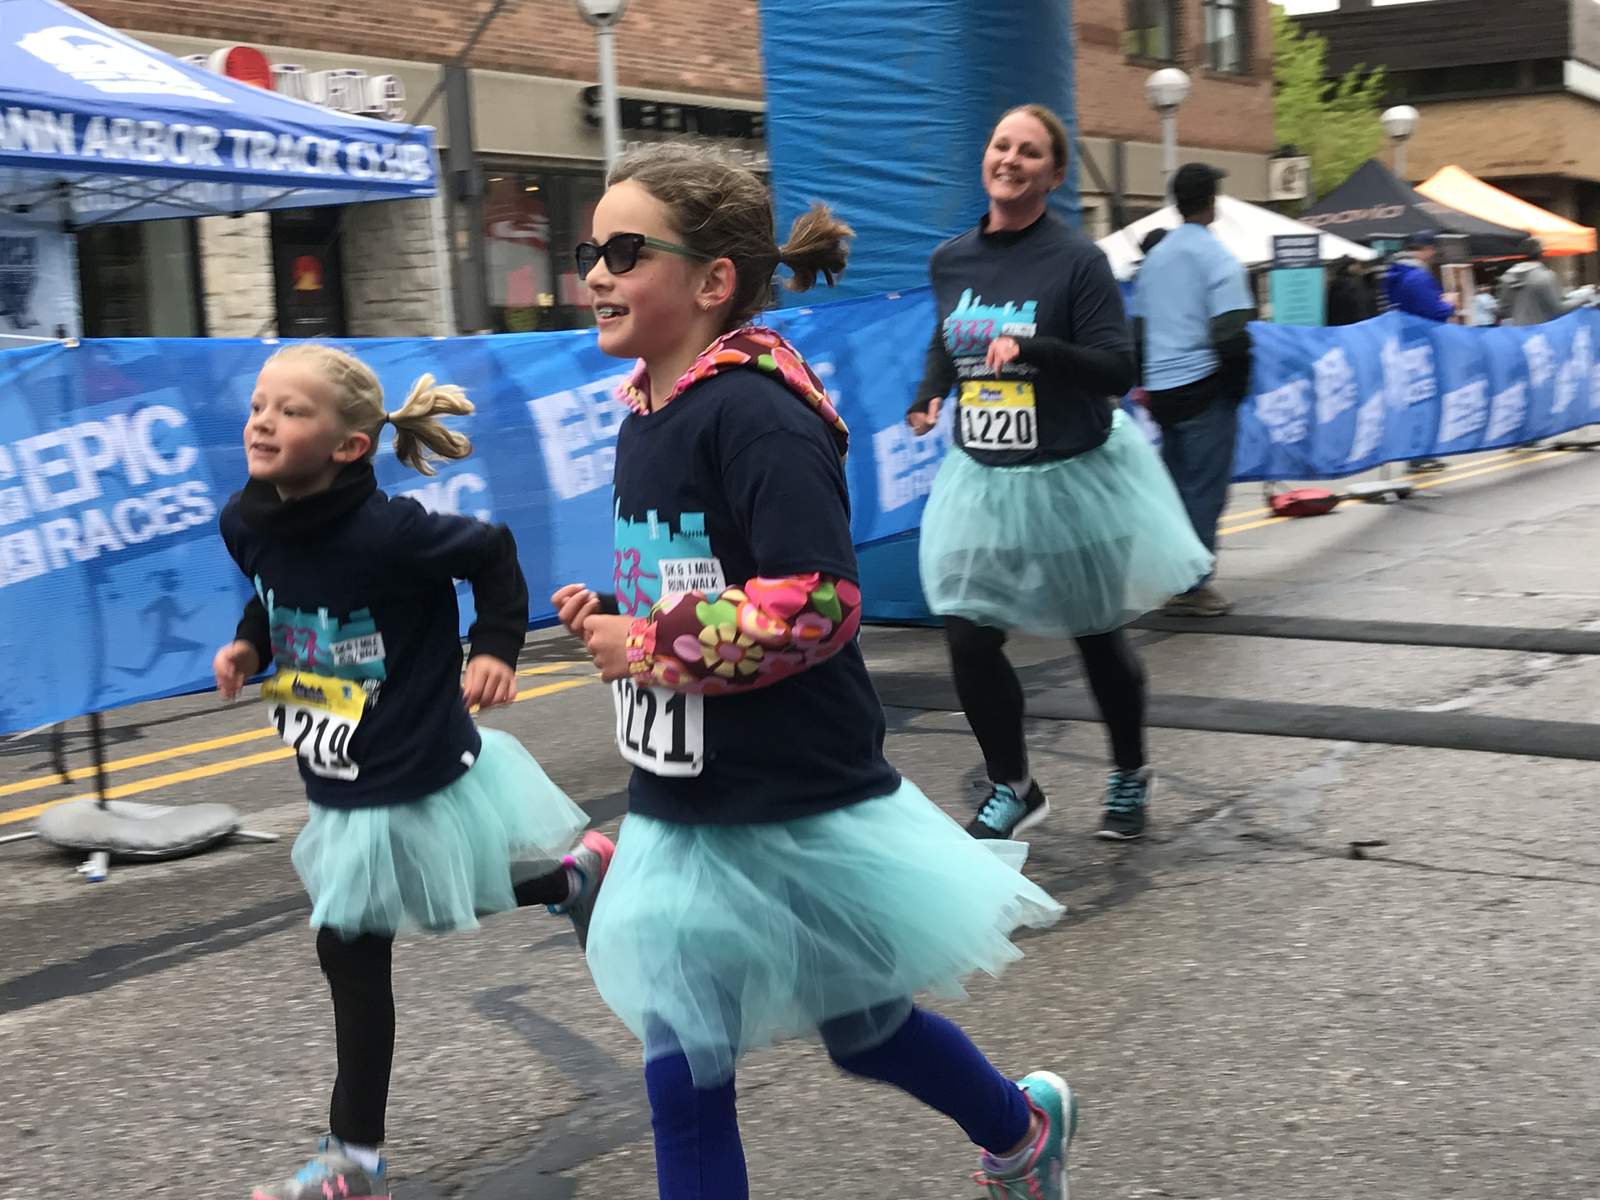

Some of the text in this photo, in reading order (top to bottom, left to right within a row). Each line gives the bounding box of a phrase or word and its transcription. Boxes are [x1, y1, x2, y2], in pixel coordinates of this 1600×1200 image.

[80, 115, 224, 168] ARBOR
[224, 127, 346, 176] TRACK
[14, 404, 200, 513] EPIC
[965, 409, 1033, 445] 1220
[40, 480, 218, 569] RACES
[272, 702, 353, 769] 1219
